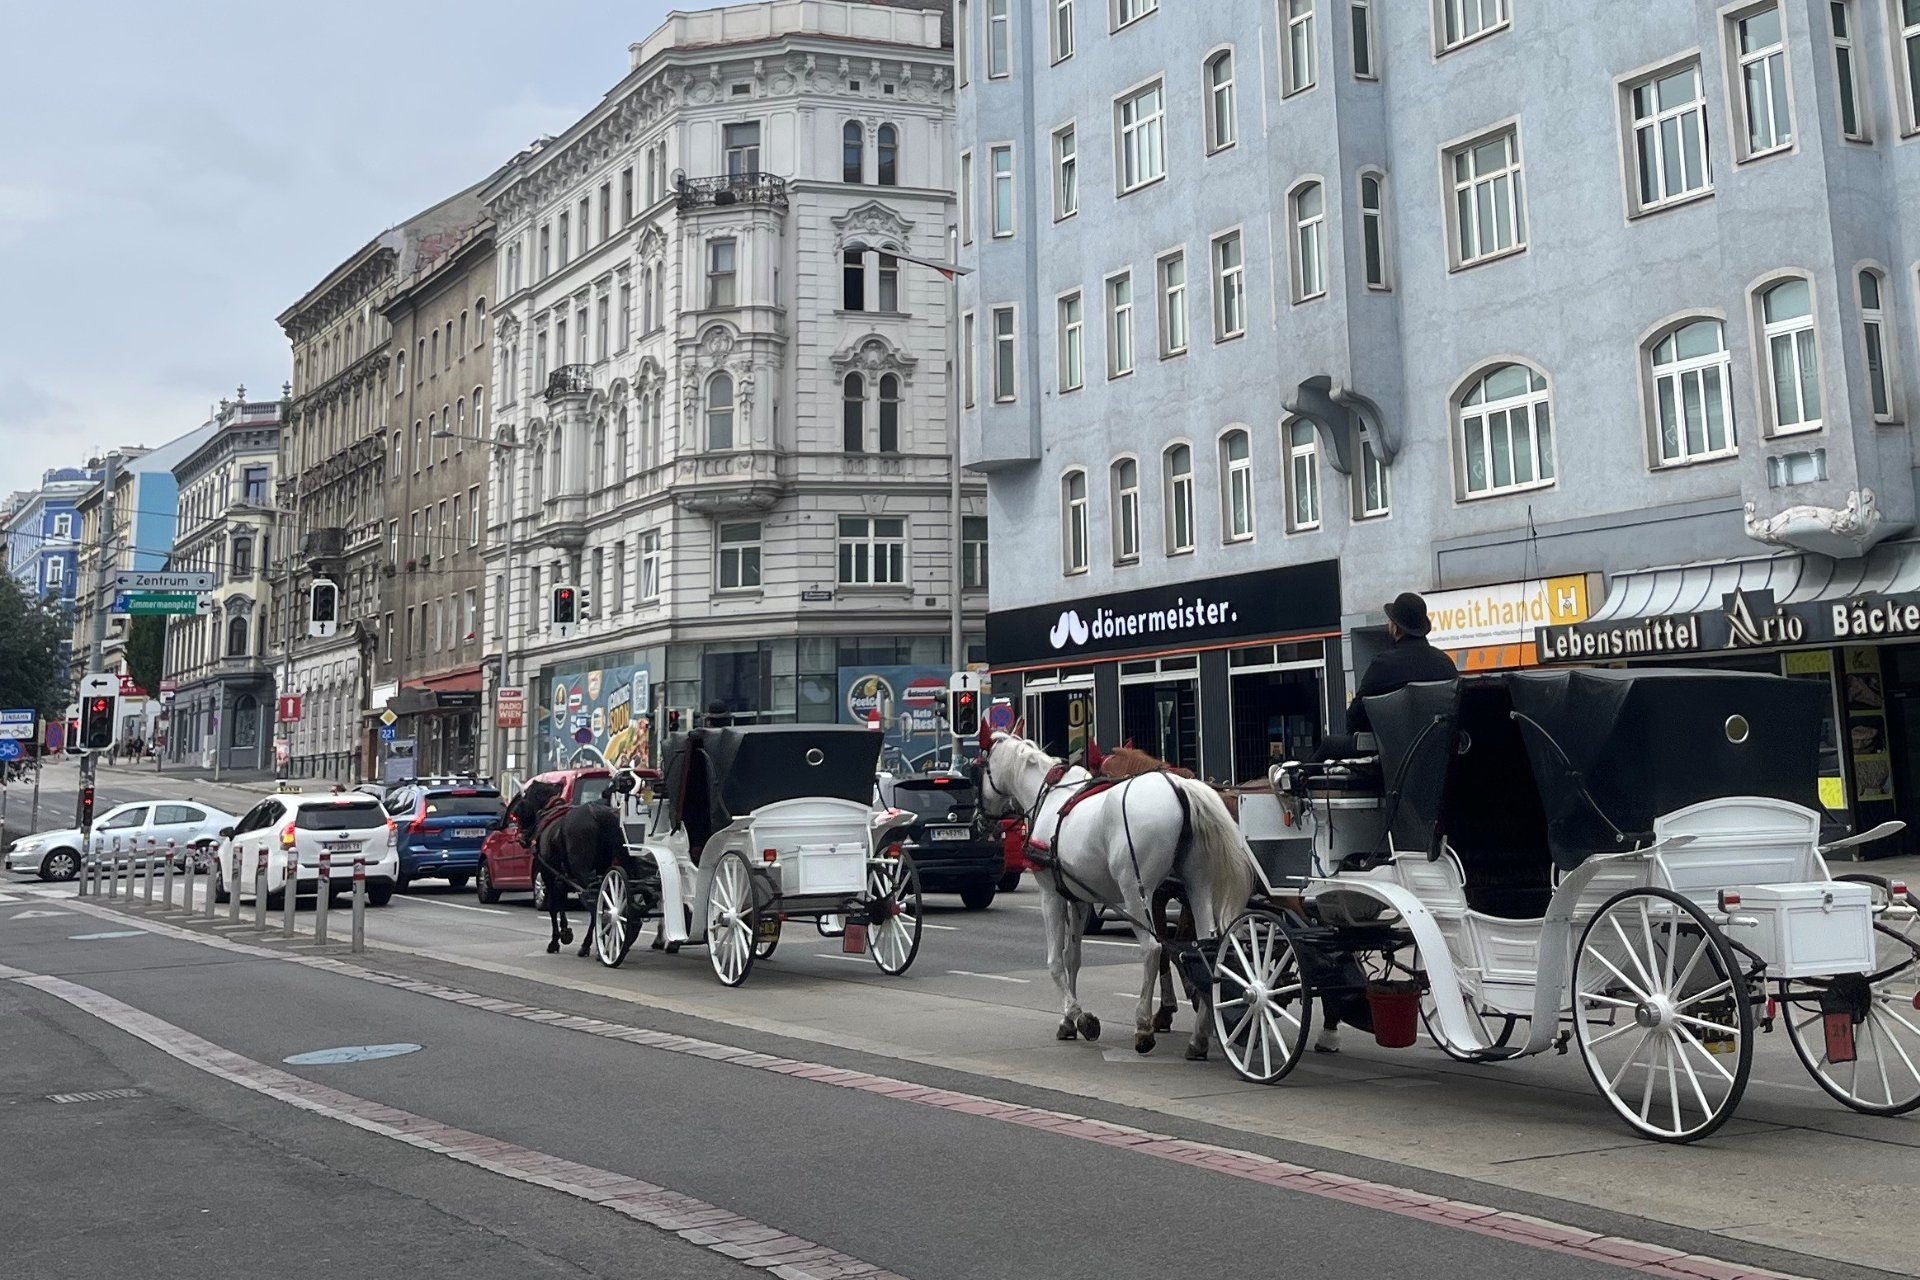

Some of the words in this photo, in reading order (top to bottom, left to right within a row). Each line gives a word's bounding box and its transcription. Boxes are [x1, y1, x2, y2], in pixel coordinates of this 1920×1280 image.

[136, 575, 189, 586] Zentrum
[129, 599, 195, 610] Zimmermannplatz
[1091, 597, 1238, 640] dönermeister.
[1541, 615, 1699, 660] Lebensmittel
[1723, 587, 1803, 649] Ario
[499, 702, 522, 710] RADIO
[499, 710, 522, 718] WIEN
[382, 729, 396, 739] 221
